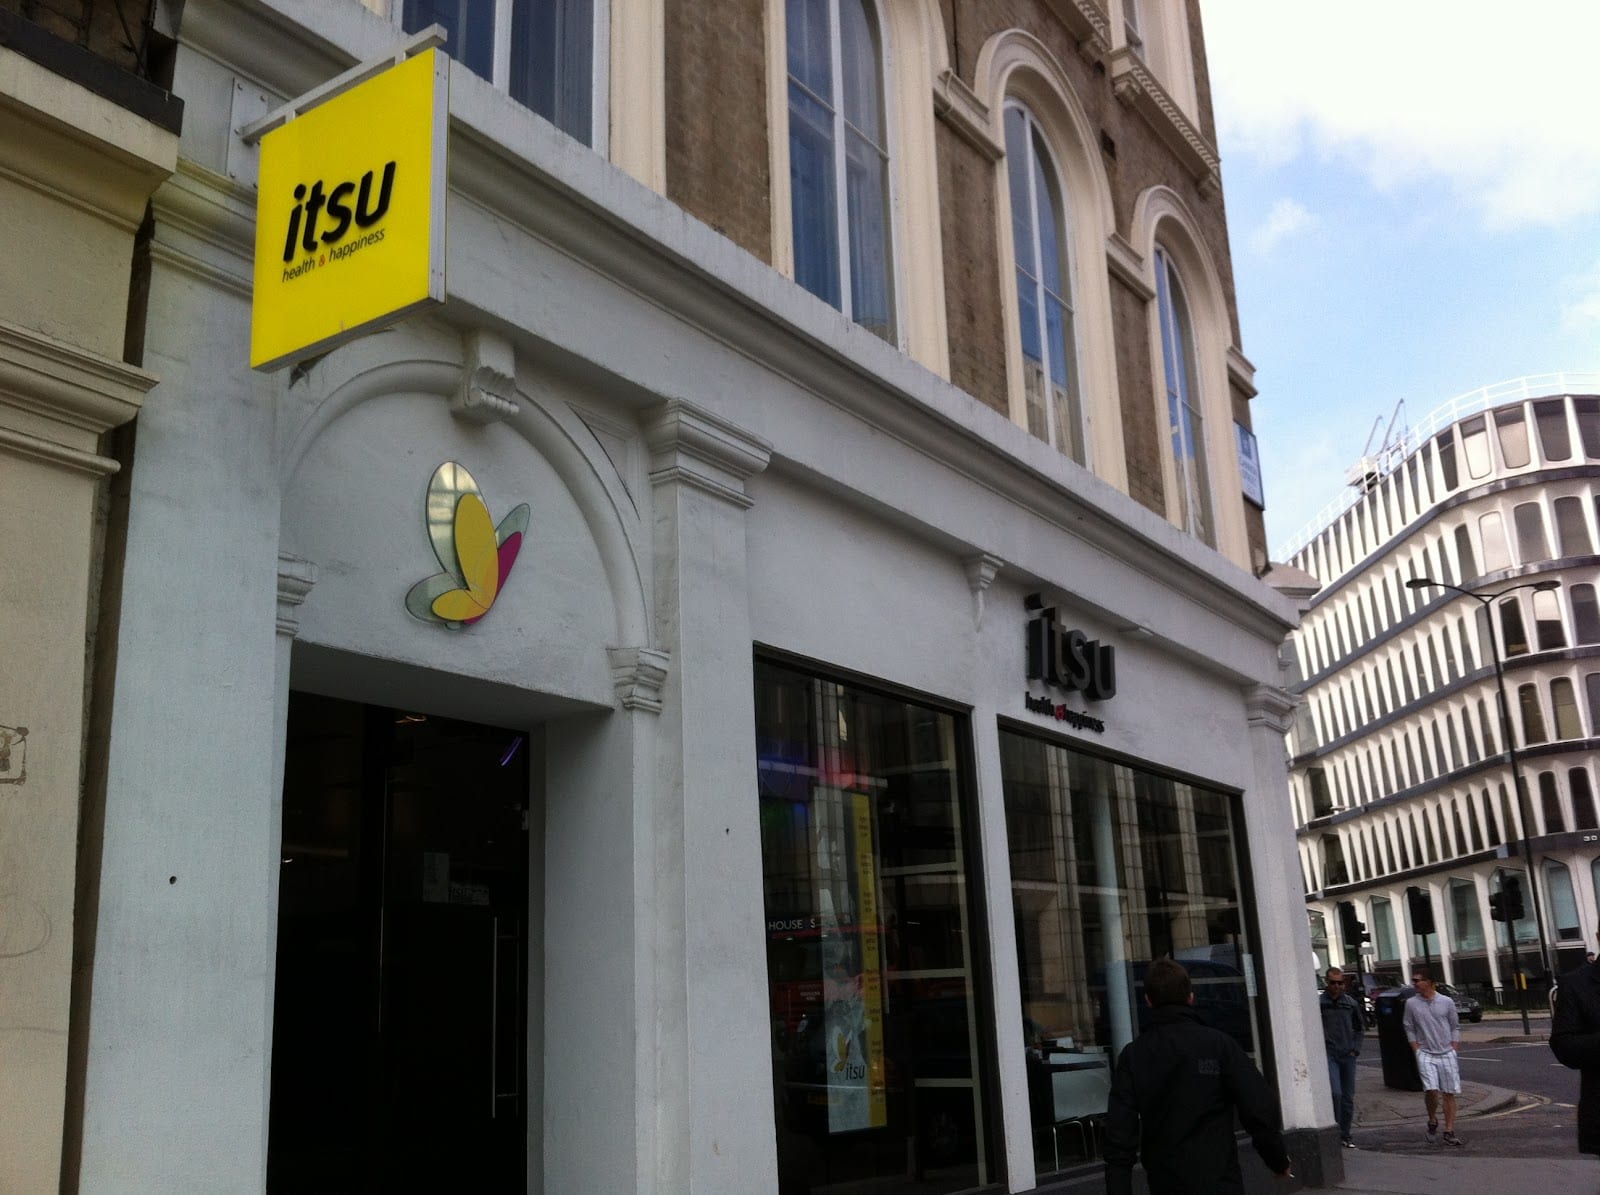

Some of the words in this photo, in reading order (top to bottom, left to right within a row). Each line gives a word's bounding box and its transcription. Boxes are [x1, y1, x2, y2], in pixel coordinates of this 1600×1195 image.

[283, 160, 396, 263] itsu
[282, 256, 316, 282] health
[318, 254, 326, 267] &
[328, 228, 385, 262] happiness
[1024, 592, 1116, 700] itsu
[768, 919, 803, 931] HOUSE
